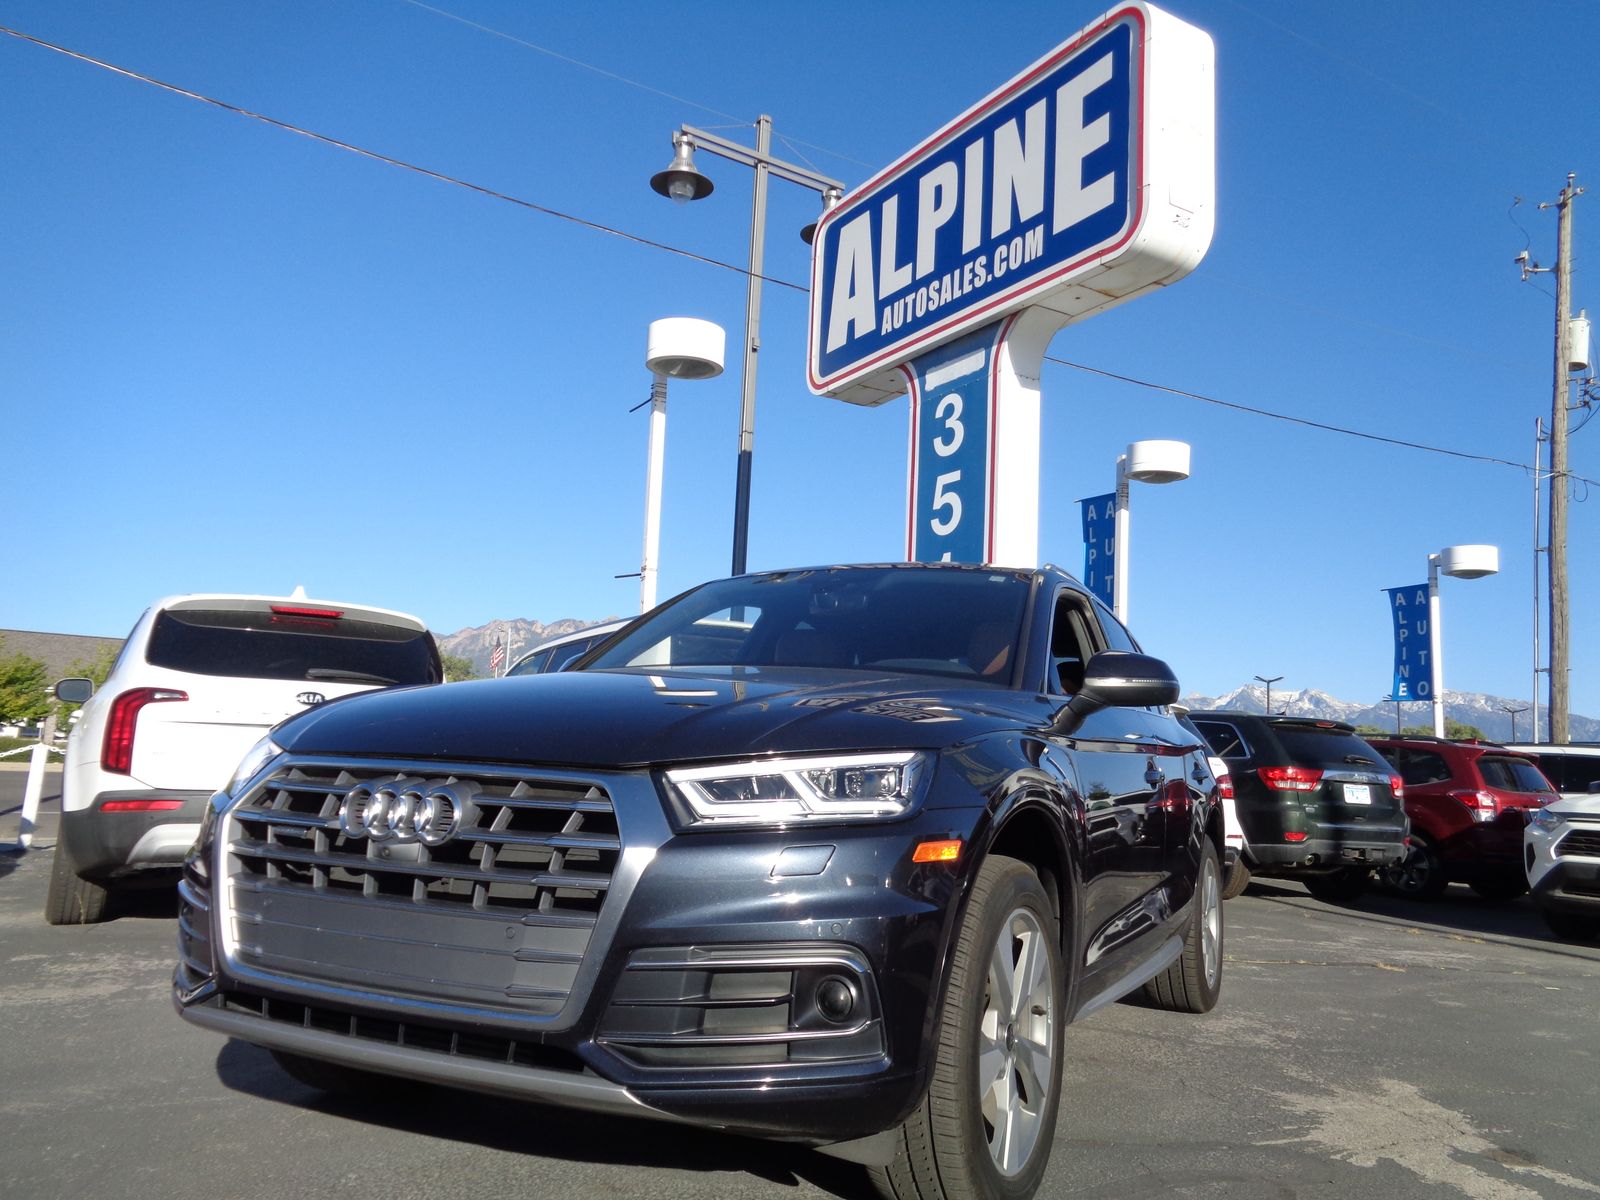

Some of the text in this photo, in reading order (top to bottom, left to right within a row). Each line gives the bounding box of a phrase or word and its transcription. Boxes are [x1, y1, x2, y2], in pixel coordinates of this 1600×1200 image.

[826, 51, 1114, 354] ALPINE
[881, 225, 1044, 336] AUTOSALES.COM
[930, 393, 965, 562] 35
[1088, 504, 1097, 595] ALPI
[1395, 592, 1409, 696] ALPINE
[1415, 590, 1429, 696] AUTO
[299, 692, 323, 704] KIA
